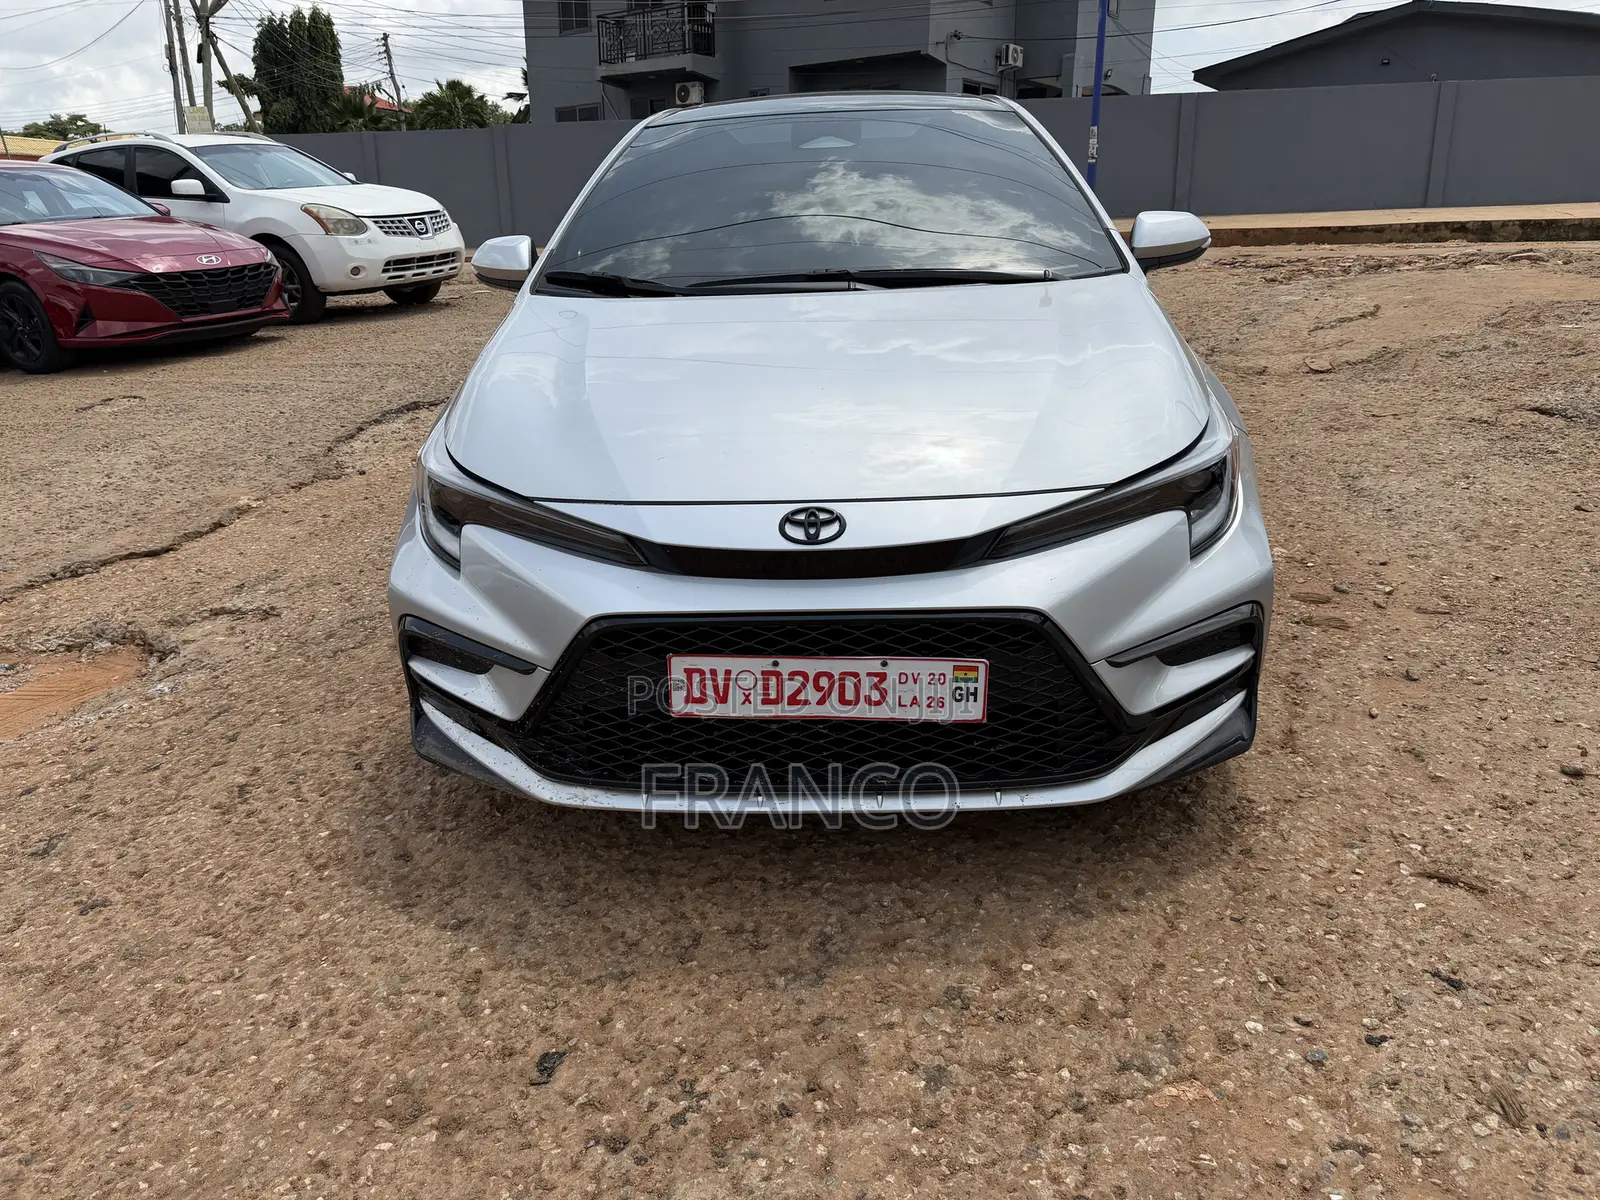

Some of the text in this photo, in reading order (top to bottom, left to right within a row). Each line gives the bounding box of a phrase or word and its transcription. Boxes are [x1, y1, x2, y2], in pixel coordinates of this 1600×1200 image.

[898, 672, 946, 685] DV 20
[683, 667, 732, 704] DV
[760, 670, 888, 707] D2903
[952, 686, 978, 702] GH
[897, 695, 945, 708] LA 26
